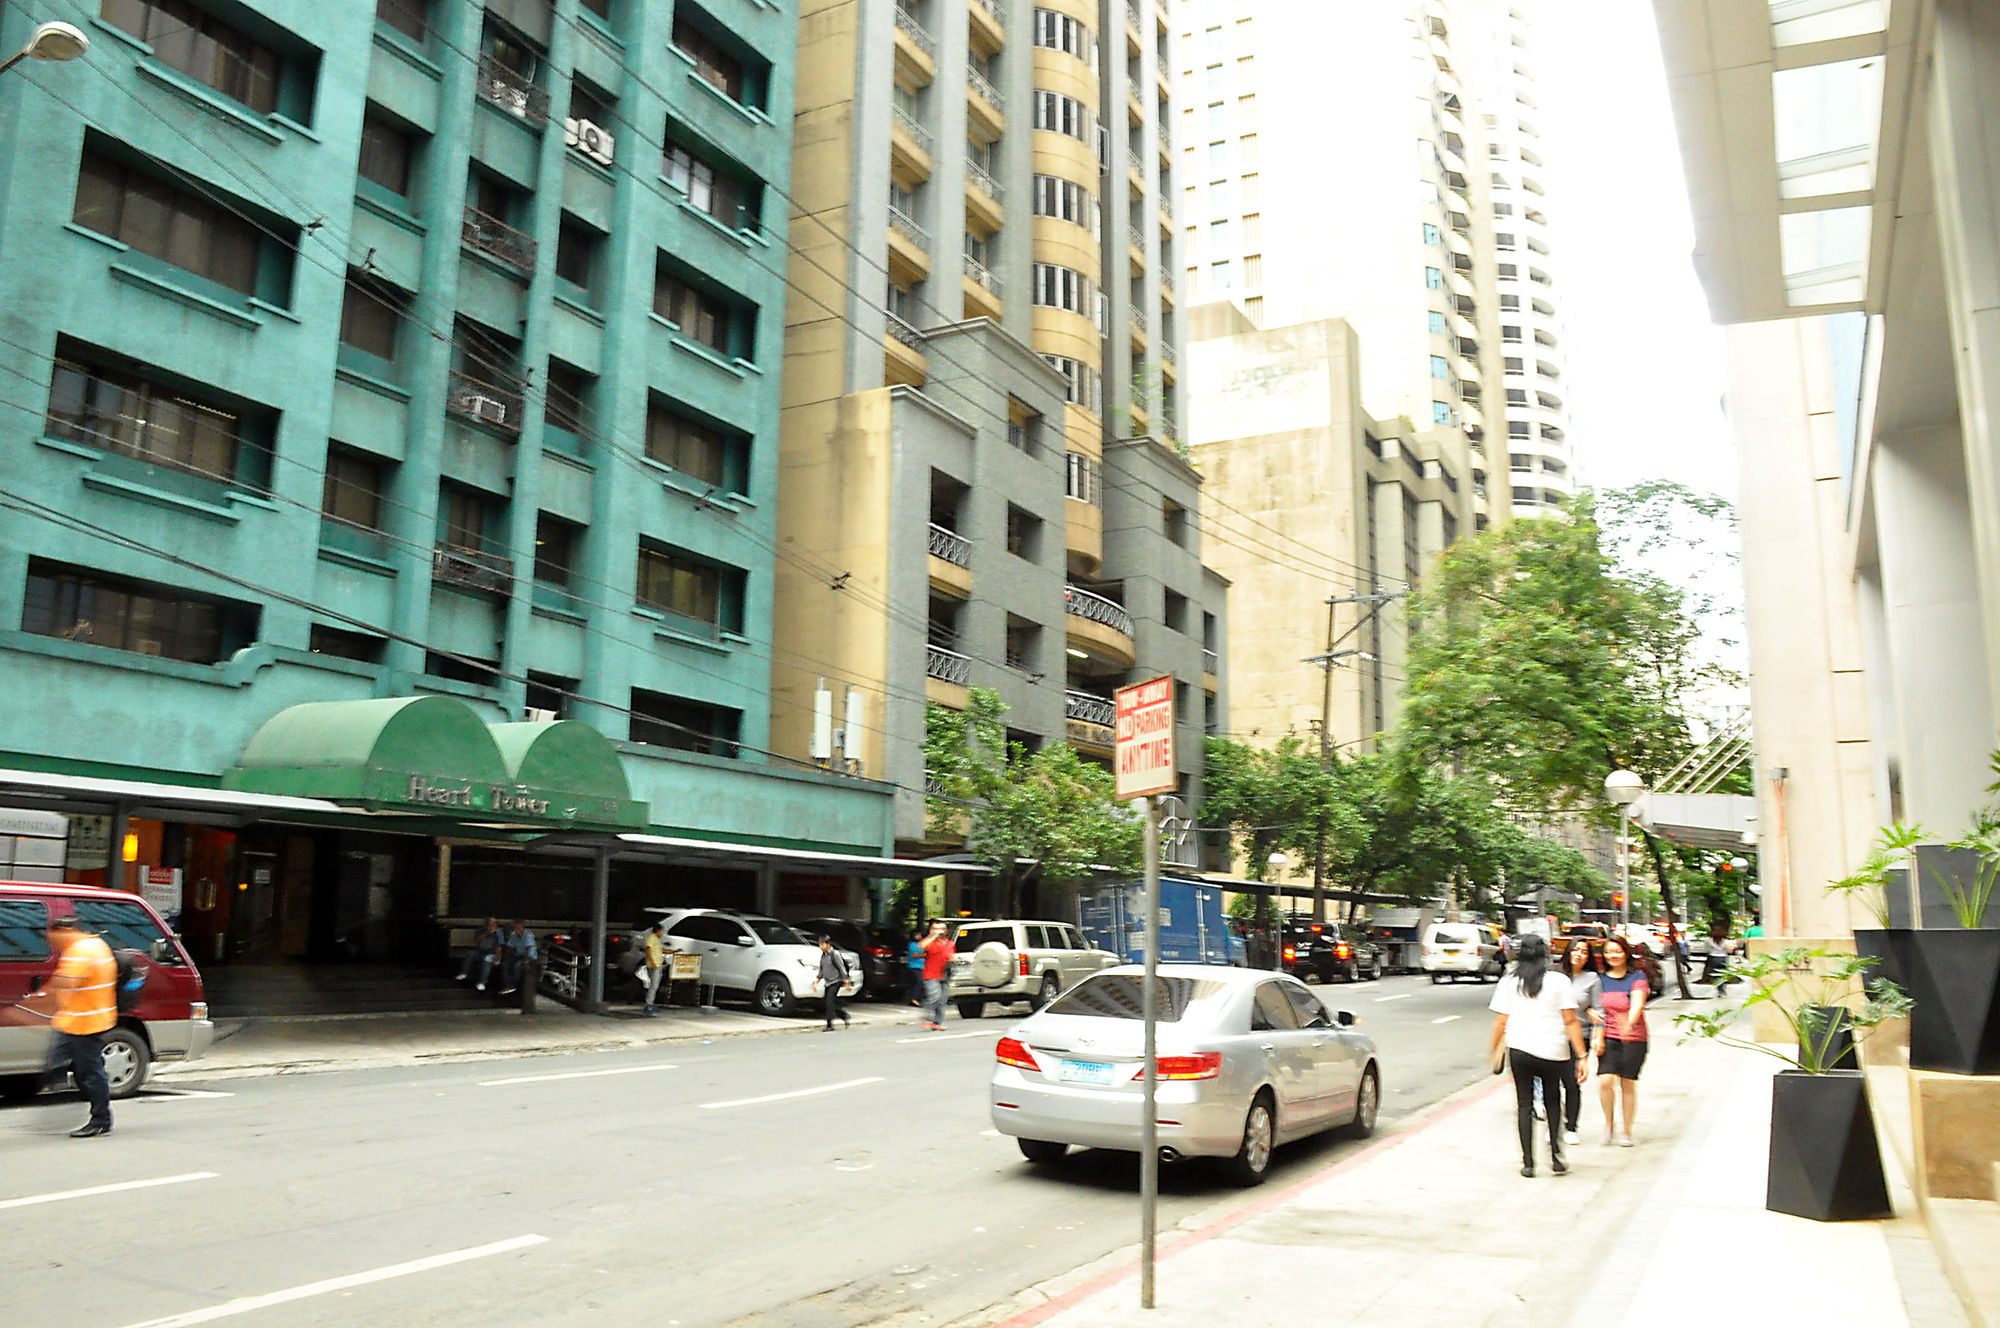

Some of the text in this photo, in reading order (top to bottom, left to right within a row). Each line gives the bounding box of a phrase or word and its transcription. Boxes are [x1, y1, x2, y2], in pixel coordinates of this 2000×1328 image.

[1119, 706, 1170, 739] NO PARKING
[1121, 738, 1171, 775] ANYTIME
[407, 773, 550, 815] Heart Tower
